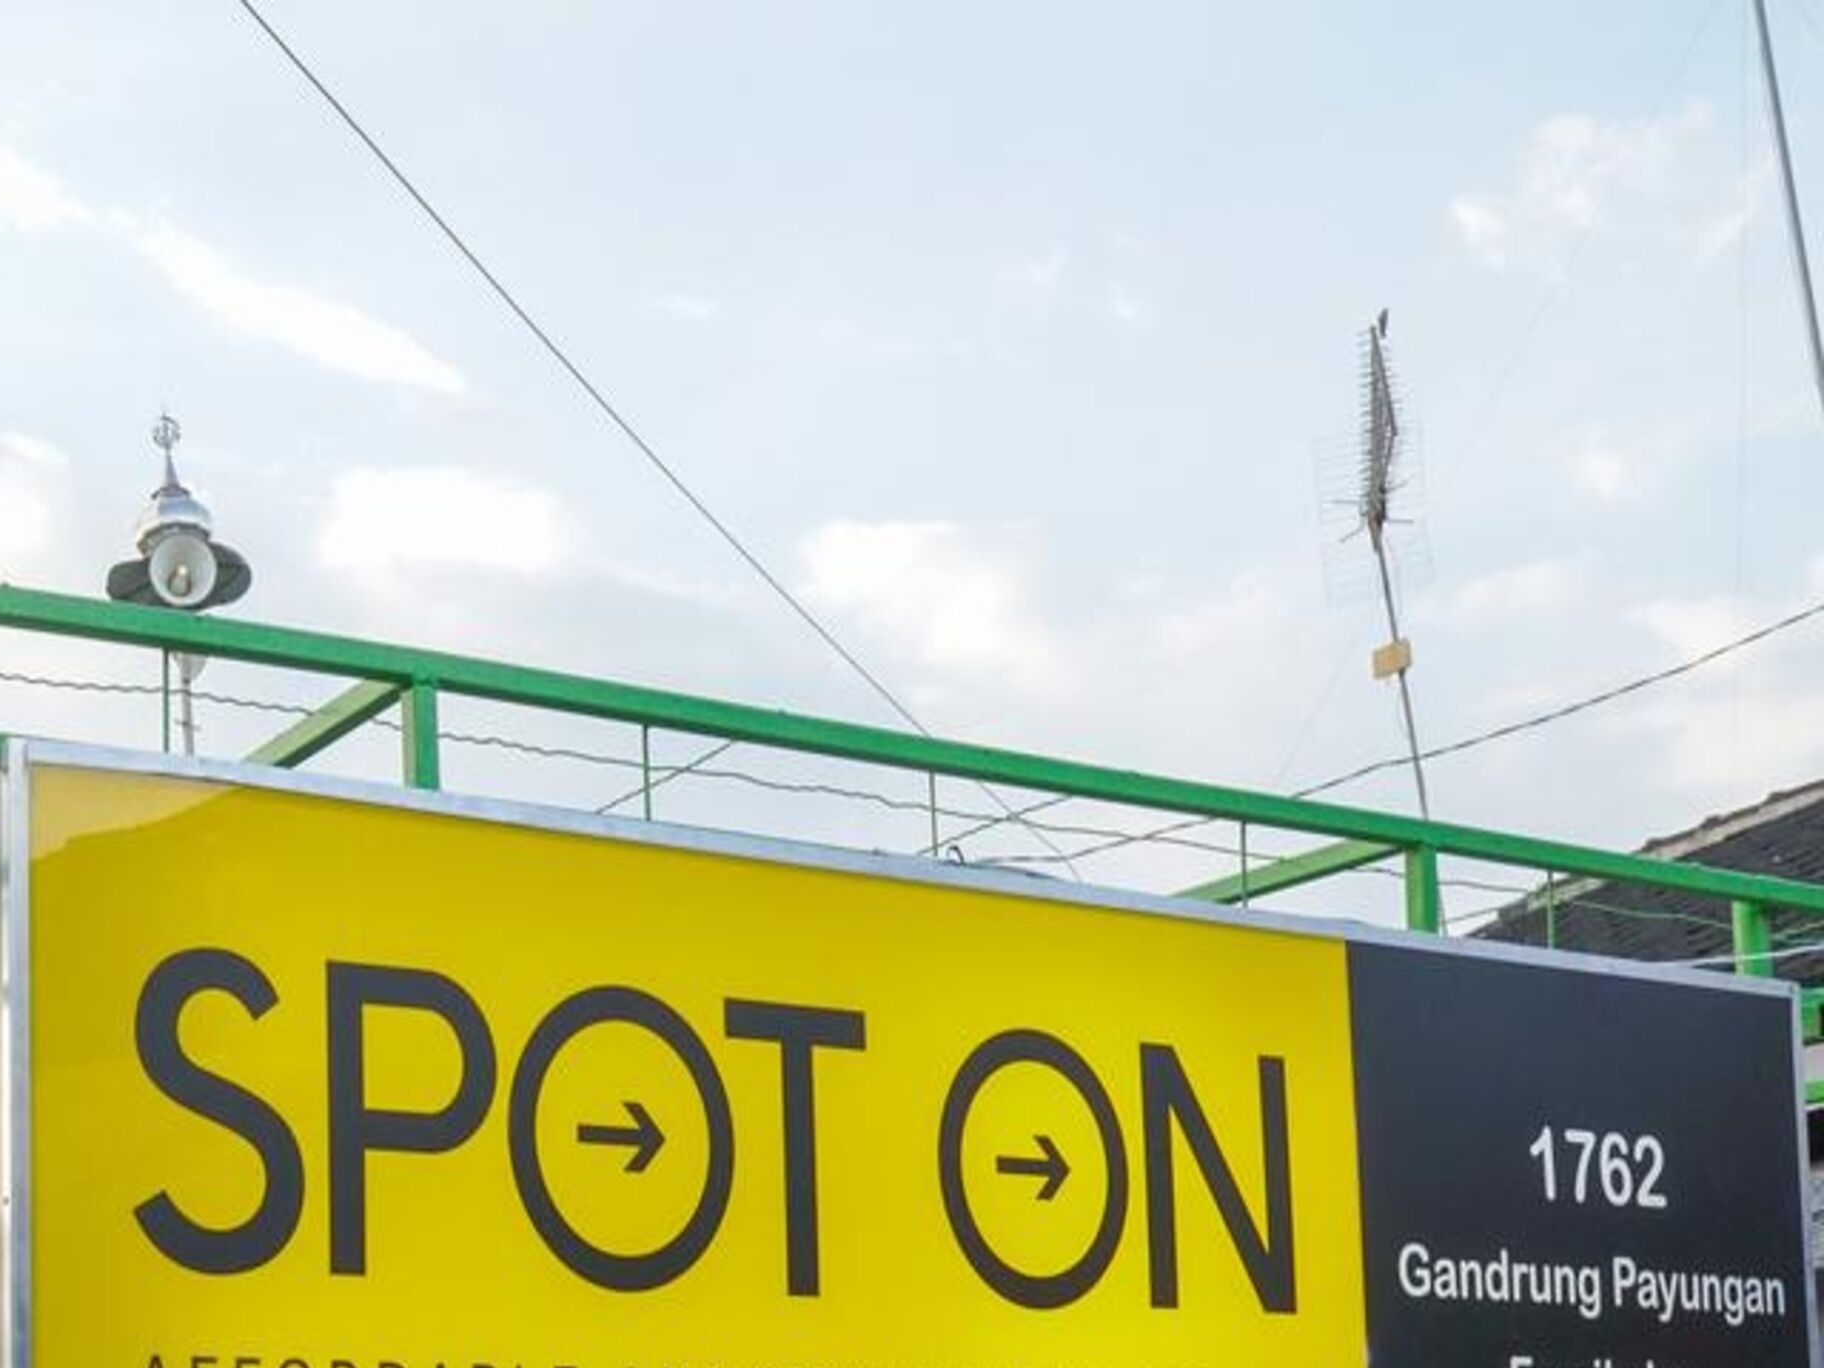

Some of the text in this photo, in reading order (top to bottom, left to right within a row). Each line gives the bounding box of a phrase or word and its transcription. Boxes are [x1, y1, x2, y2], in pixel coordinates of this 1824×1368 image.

[133, 947, 1297, 1314] SPOT ON
[1530, 1126, 1667, 1207] 1762
[1398, 1243, 1785, 1326] Gandrung Payungan
